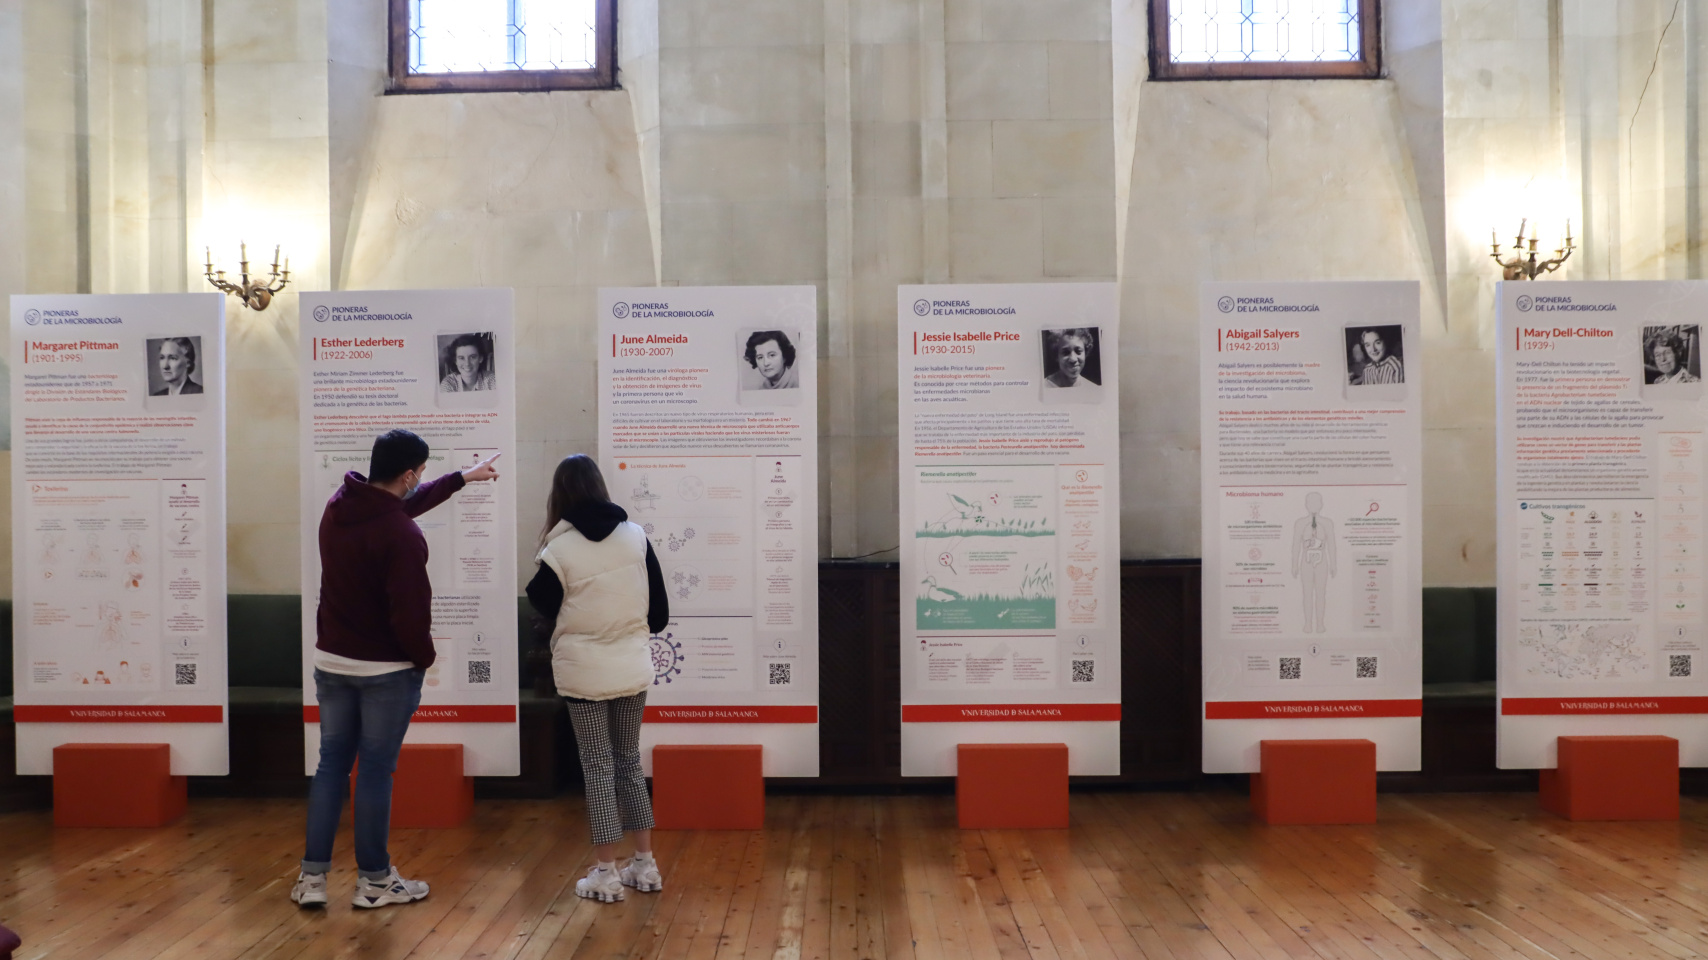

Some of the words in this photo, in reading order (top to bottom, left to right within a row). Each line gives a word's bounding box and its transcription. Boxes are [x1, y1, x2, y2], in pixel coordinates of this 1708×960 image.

[955, 307, 1016, 315] MICROBIOLOGÍA
[1259, 304, 1320, 312] MICROBIOLOGÍA
[1557, 303, 1617, 311] MICROBIOLOGÍA
[354, 312, 412, 321] MICROBIOLOGÍA
[654, 309, 714, 318] MICROBIOLOGÍA
[64, 316, 122, 324] MICROBIOLOGÍA
[921, 332, 952, 341] Jessie
[953, 332, 992, 341] Isabelle
[994, 331, 1020, 341] Price
[1226, 329, 1261, 340] Abigail
[1263, 328, 1300, 340] Salyers
[1524, 328, 1551, 339] Mary
[1552, 327, 1613, 337] Dell-Chilton
[321, 338, 353, 347] Esther
[354, 337, 404, 349] Lederberg
[620, 335, 644, 344] June
[646, 334, 688, 344] Almeida
[32, 341, 78, 352] Margaret
[80, 340, 119, 350] Pittman
[921, 345, 976, 355] (1930-2015)
[1226, 342, 1280, 352] (1942-2013)
[1524, 341, 1555, 350] (1939-)
[321, 350, 373, 360] (1922-2006)
[620, 348, 673, 357] (1930-2007)
[32, 354, 83, 363] (1901-1995)
